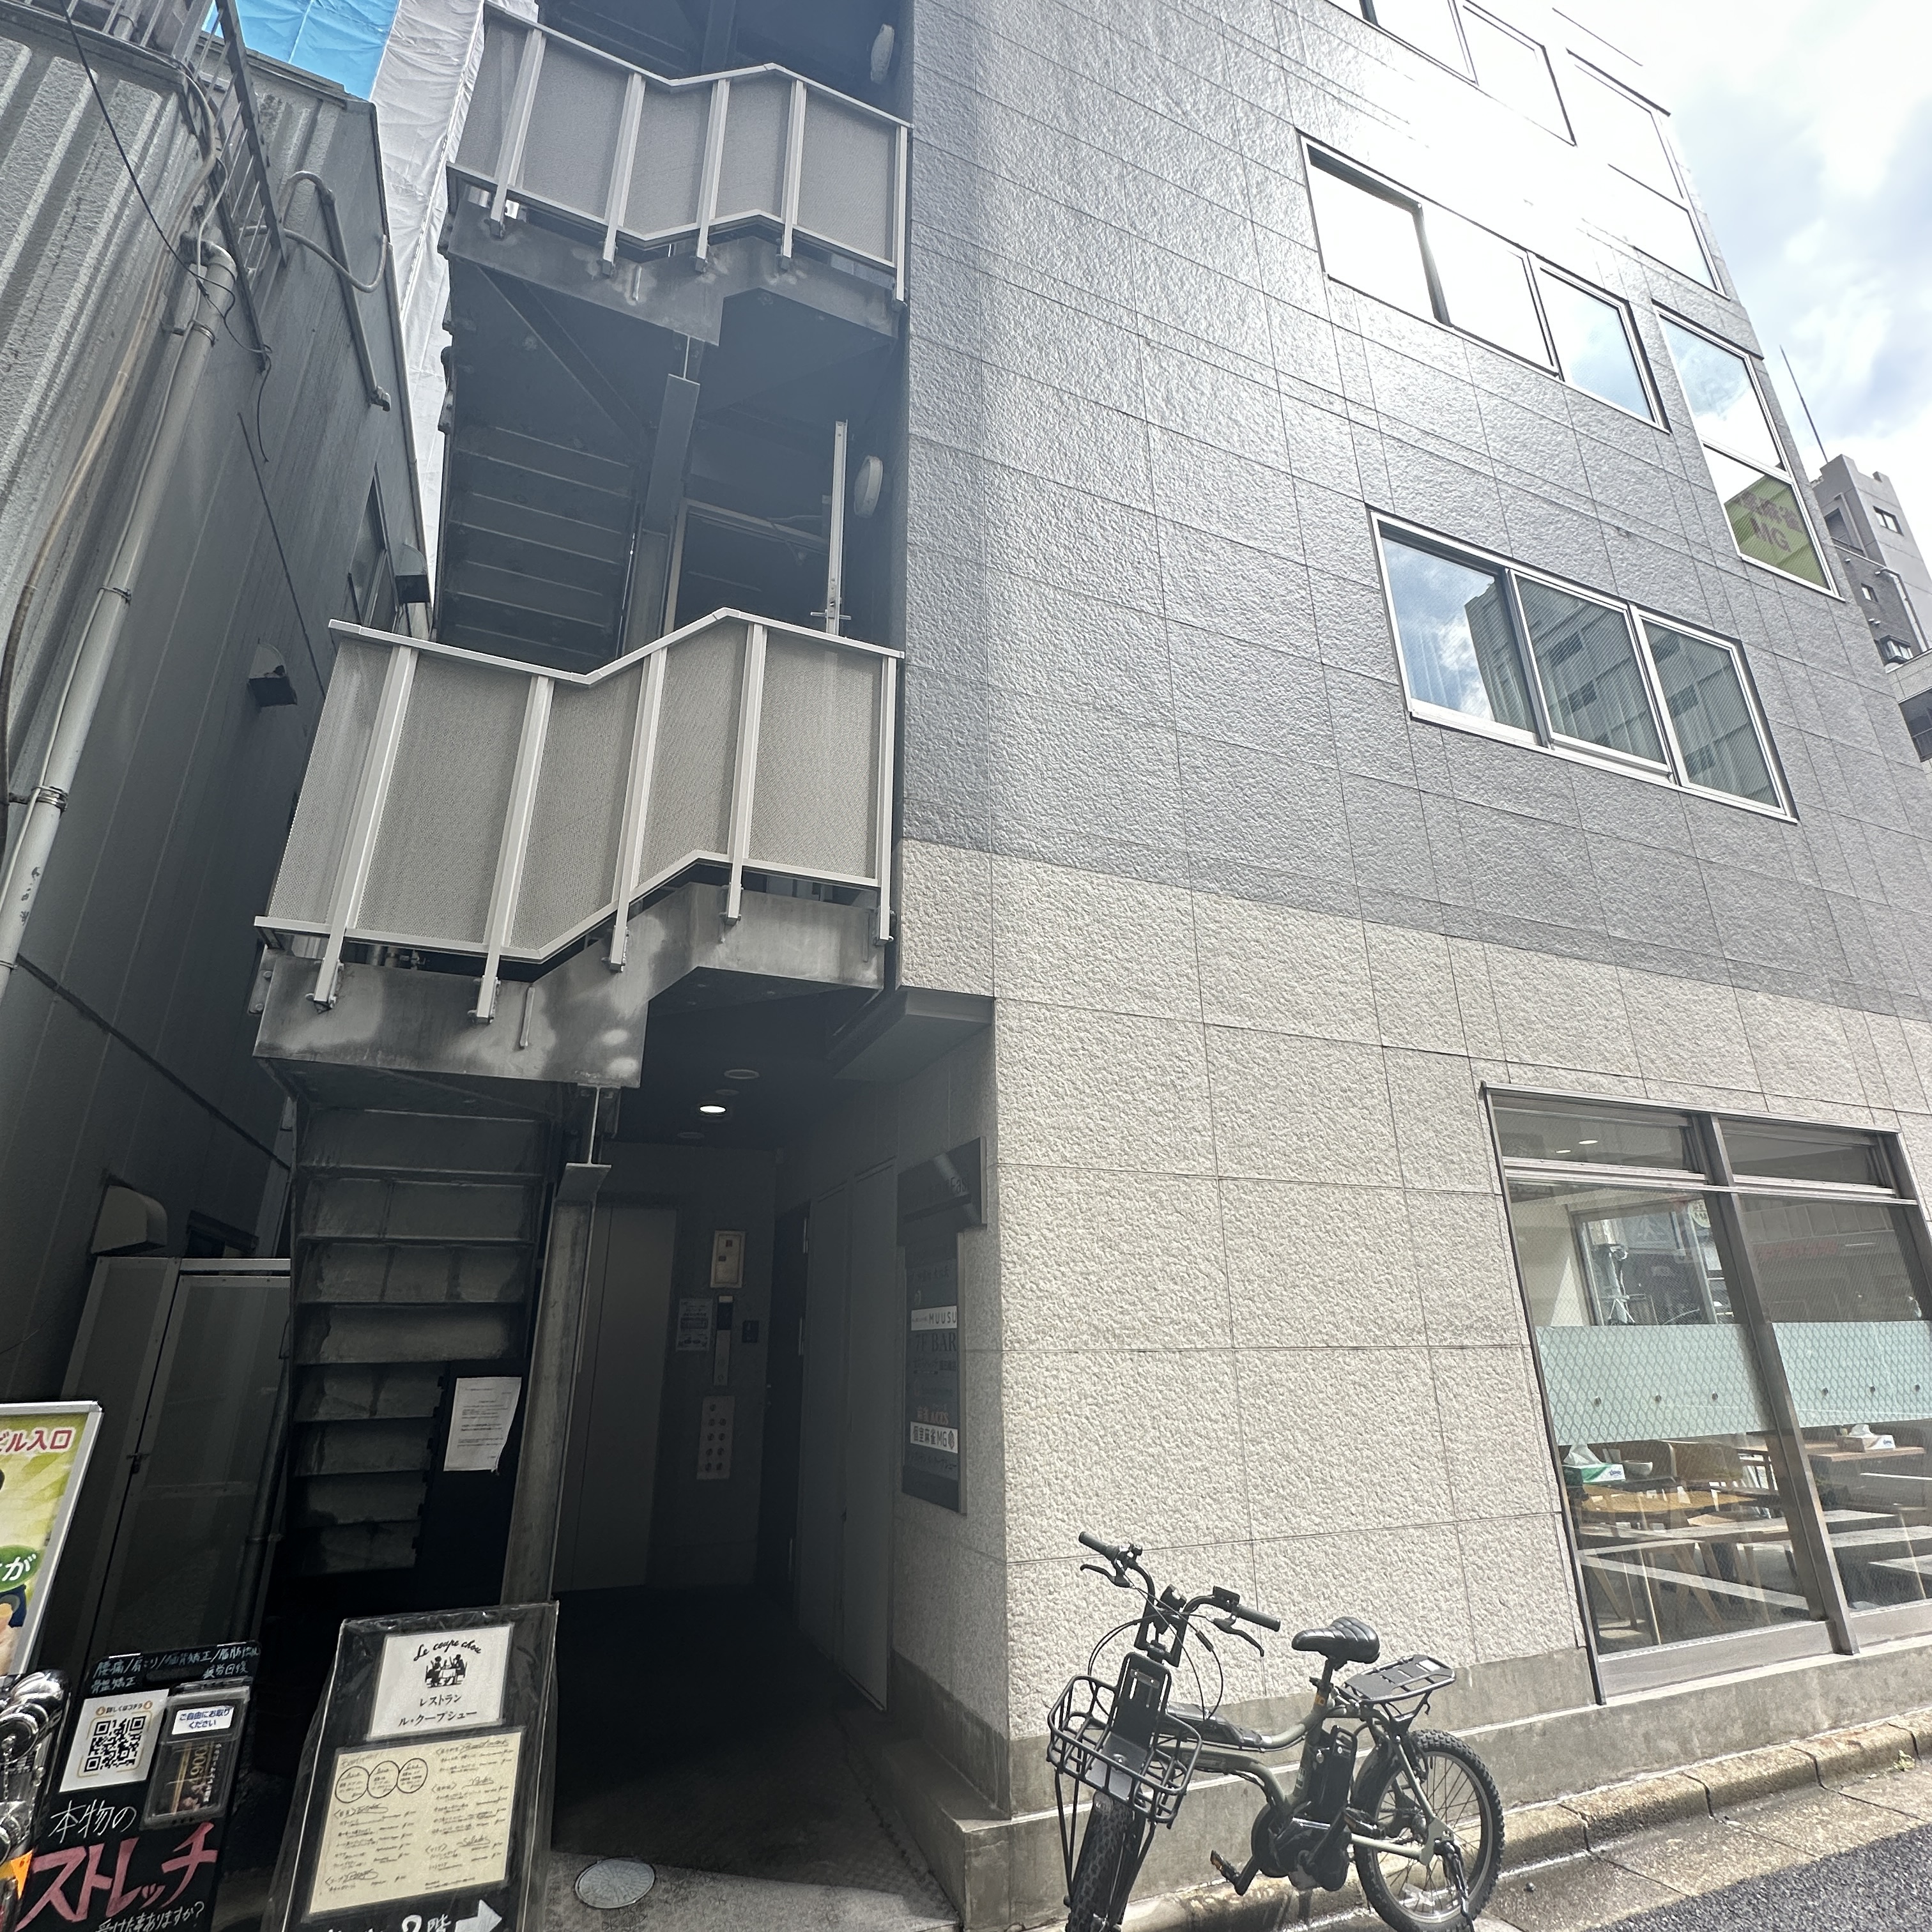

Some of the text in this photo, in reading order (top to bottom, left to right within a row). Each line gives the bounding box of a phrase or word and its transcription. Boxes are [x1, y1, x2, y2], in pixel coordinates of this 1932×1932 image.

[928, 1311, 957, 1324] MUUSU
[931, 1332, 957, 1351] BAR
[413, 1639, 482, 1662] Le coupe chou
[419, 1694, 462, 1707] レストラン
[48, 1798, 137, 1844] 本物の
[14, 1821, 218, 1932] ストレッチ
